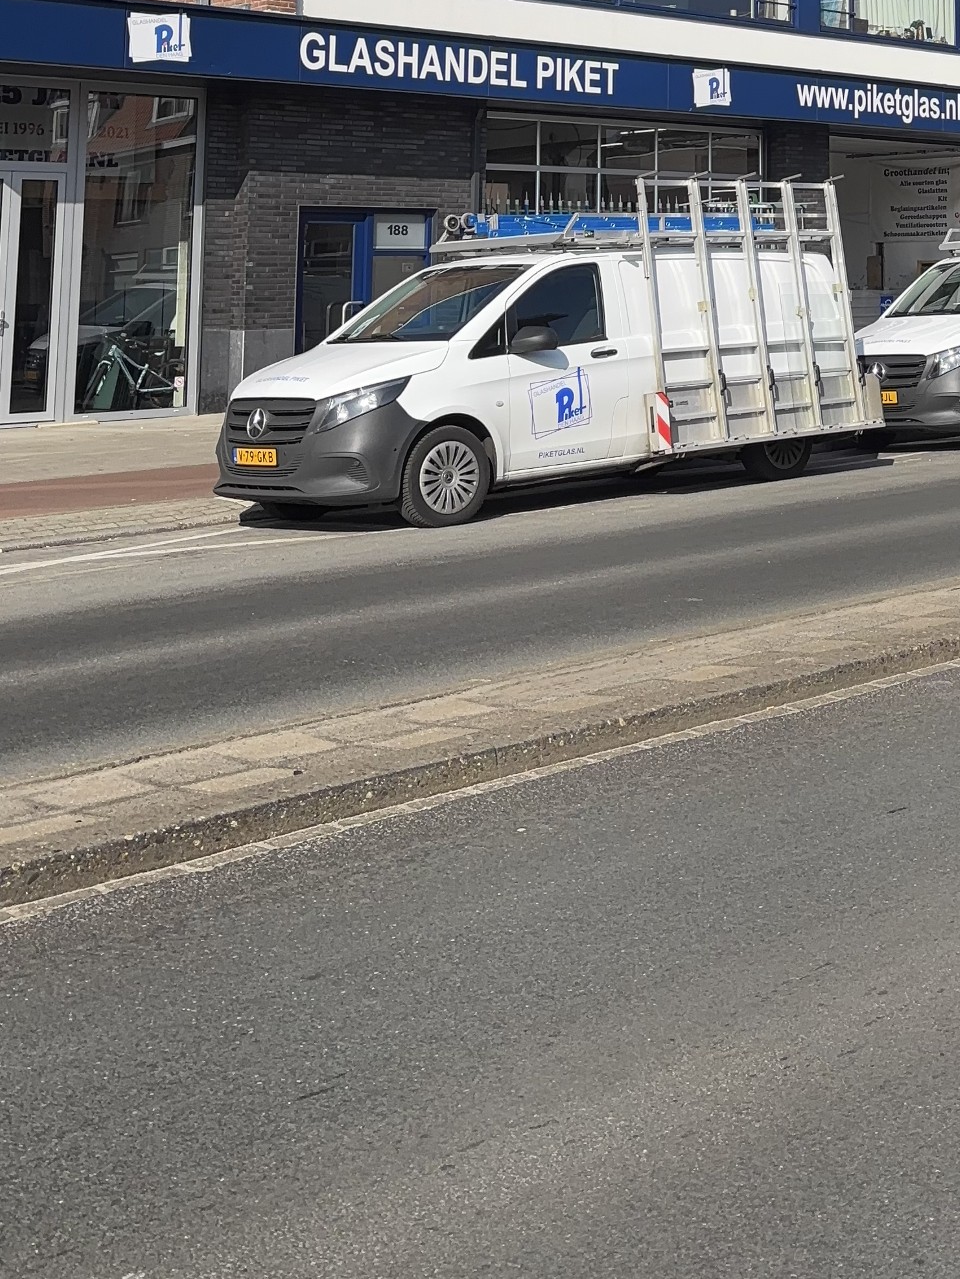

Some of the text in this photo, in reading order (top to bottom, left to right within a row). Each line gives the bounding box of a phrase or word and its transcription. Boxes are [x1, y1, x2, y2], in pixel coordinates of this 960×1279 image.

[300, 32, 620, 95] GLASHANDEL PIKET
[13, 122, 45, 136] 1996
[884, 167, 937, 177] Groothandel
[935, 179, 947, 187] glas
[387, 224, 409, 236] 188
[533, 379, 567, 397] GLASHANDEL
[238, 449, 274, 463] V-79-GKB
[538, 446, 586, 459] PIKETGLAS.NL
